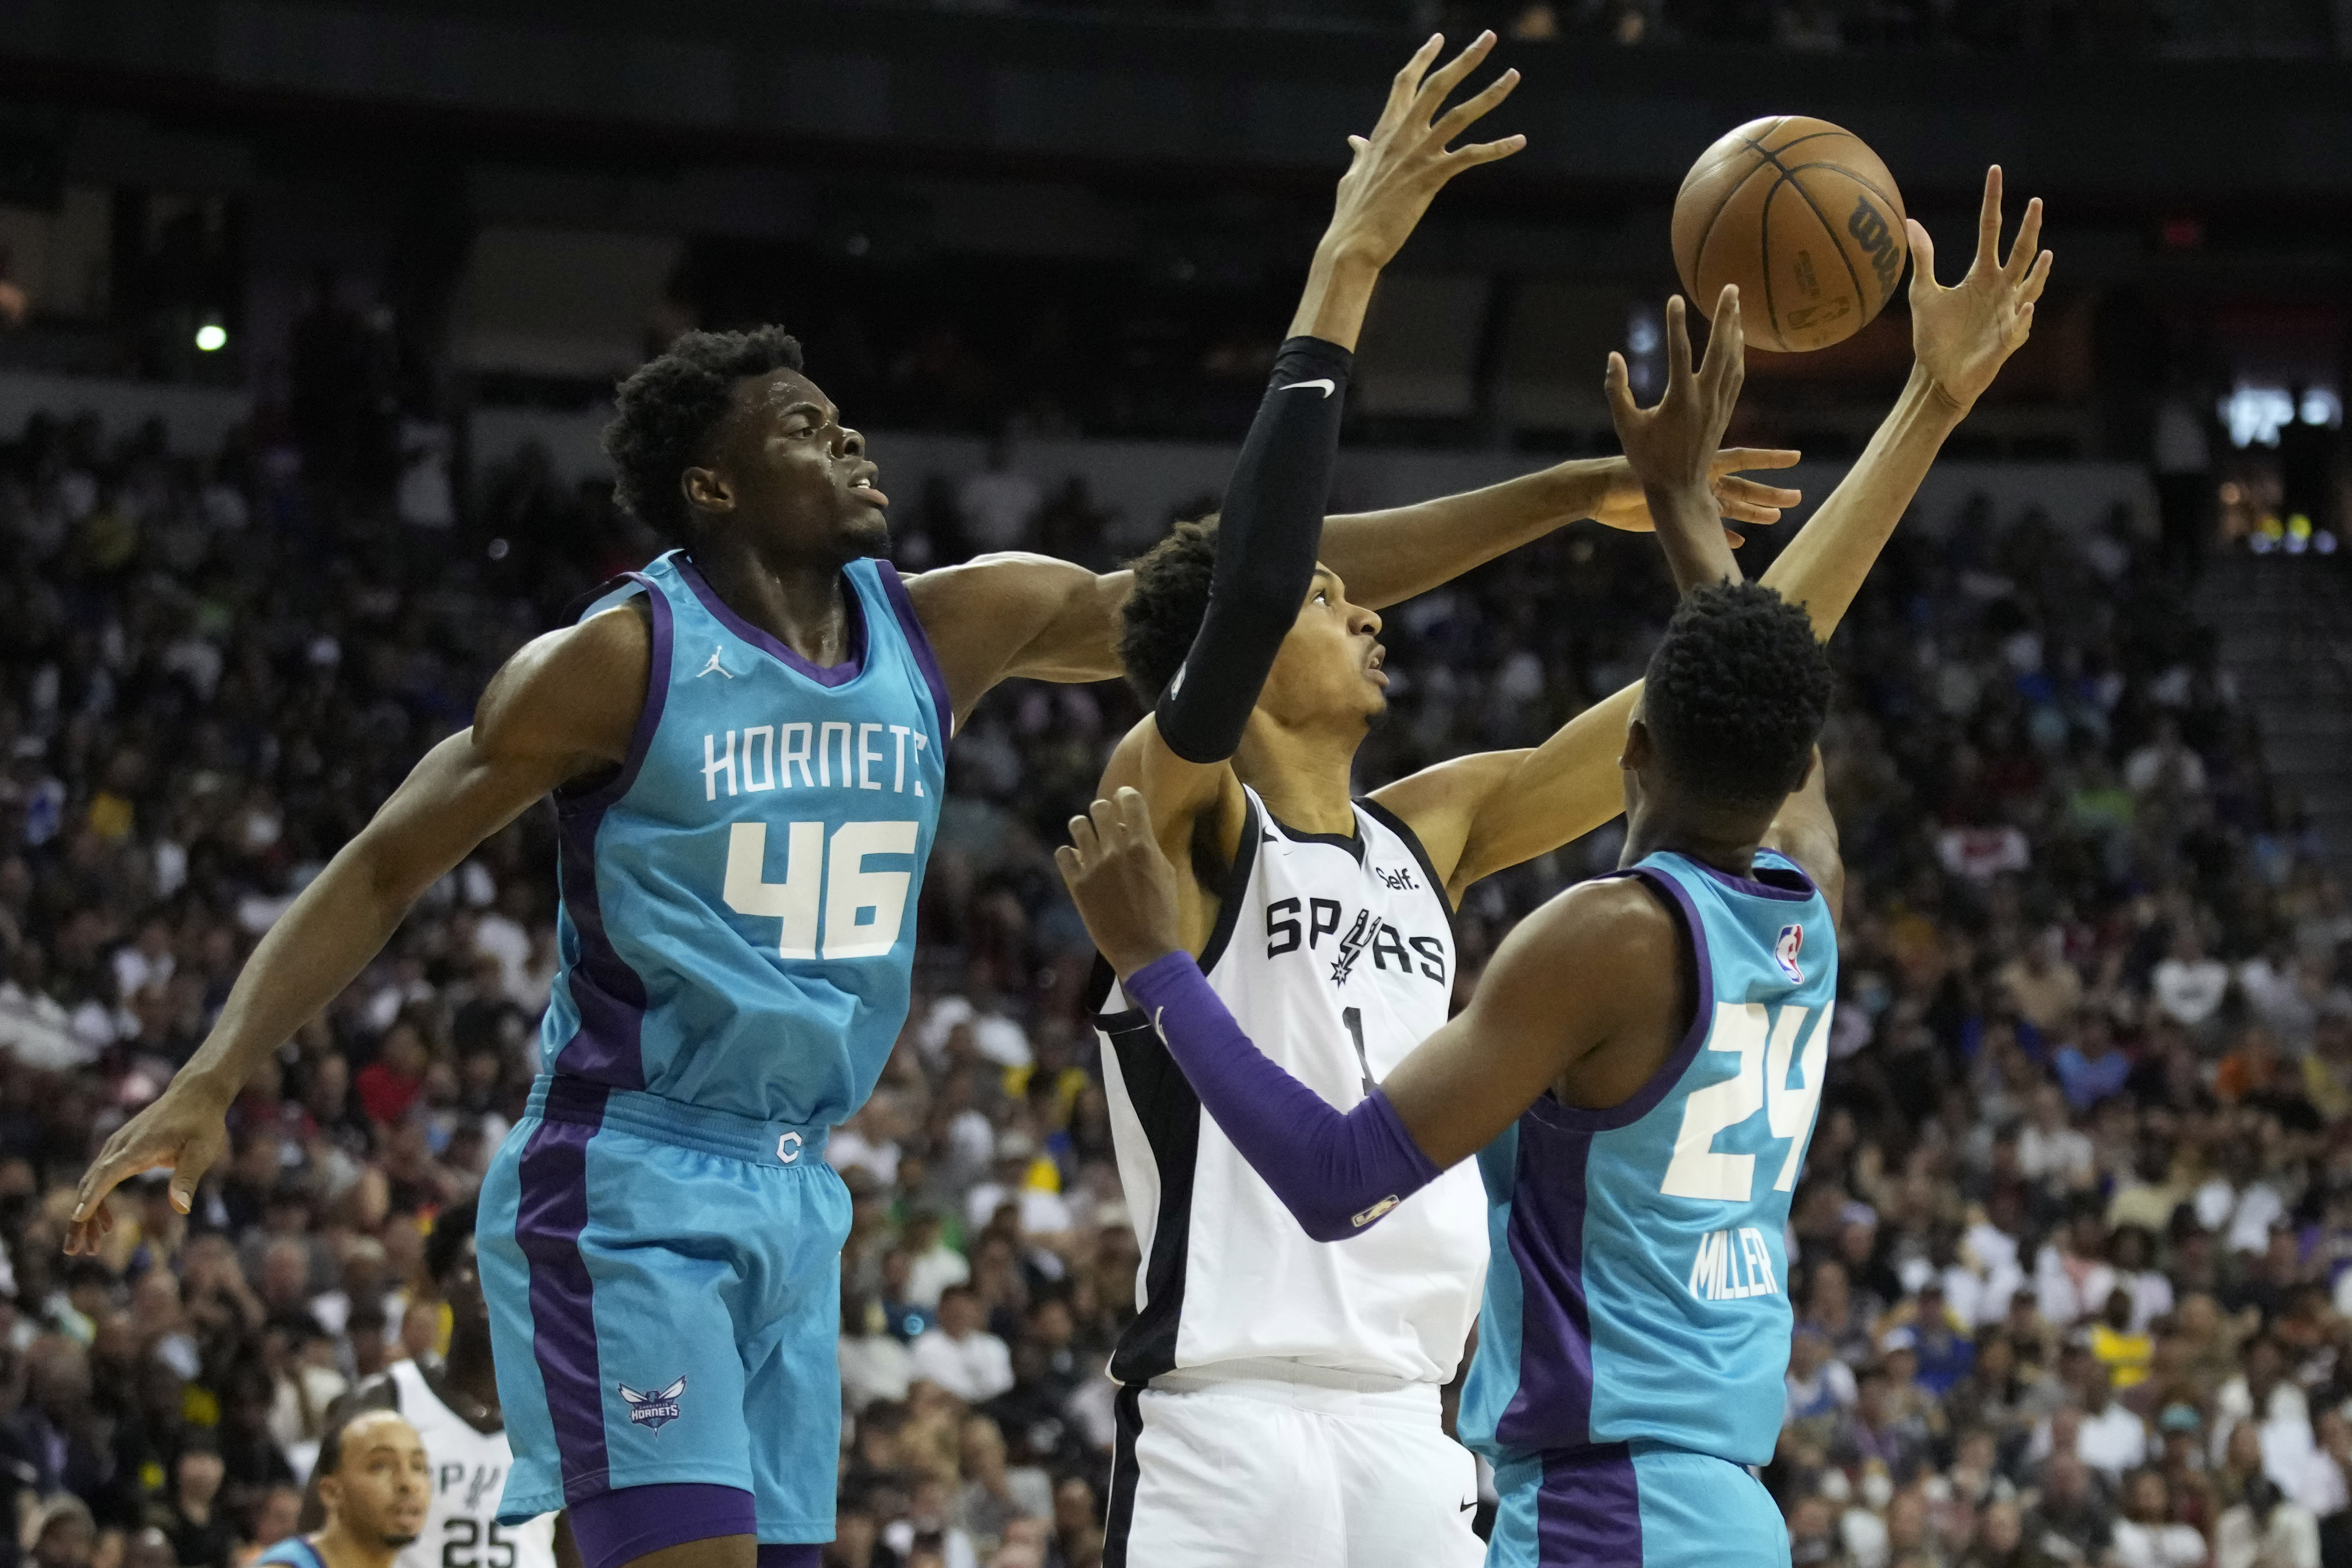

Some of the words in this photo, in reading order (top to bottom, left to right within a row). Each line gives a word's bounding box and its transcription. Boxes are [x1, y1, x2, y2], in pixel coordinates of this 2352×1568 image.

[723, 821, 919, 960] 46
[1376, 867, 1420, 890] Self.
[1266, 897, 1445, 990] SPURS
[1342, 1006, 1380, 1096] 1
[1660, 1000, 1834, 1202] 24
[1689, 1227, 1778, 1300] MILLER
[631, 1405, 678, 1421] HORNETS
[443, 1518, 516, 1568] 25
